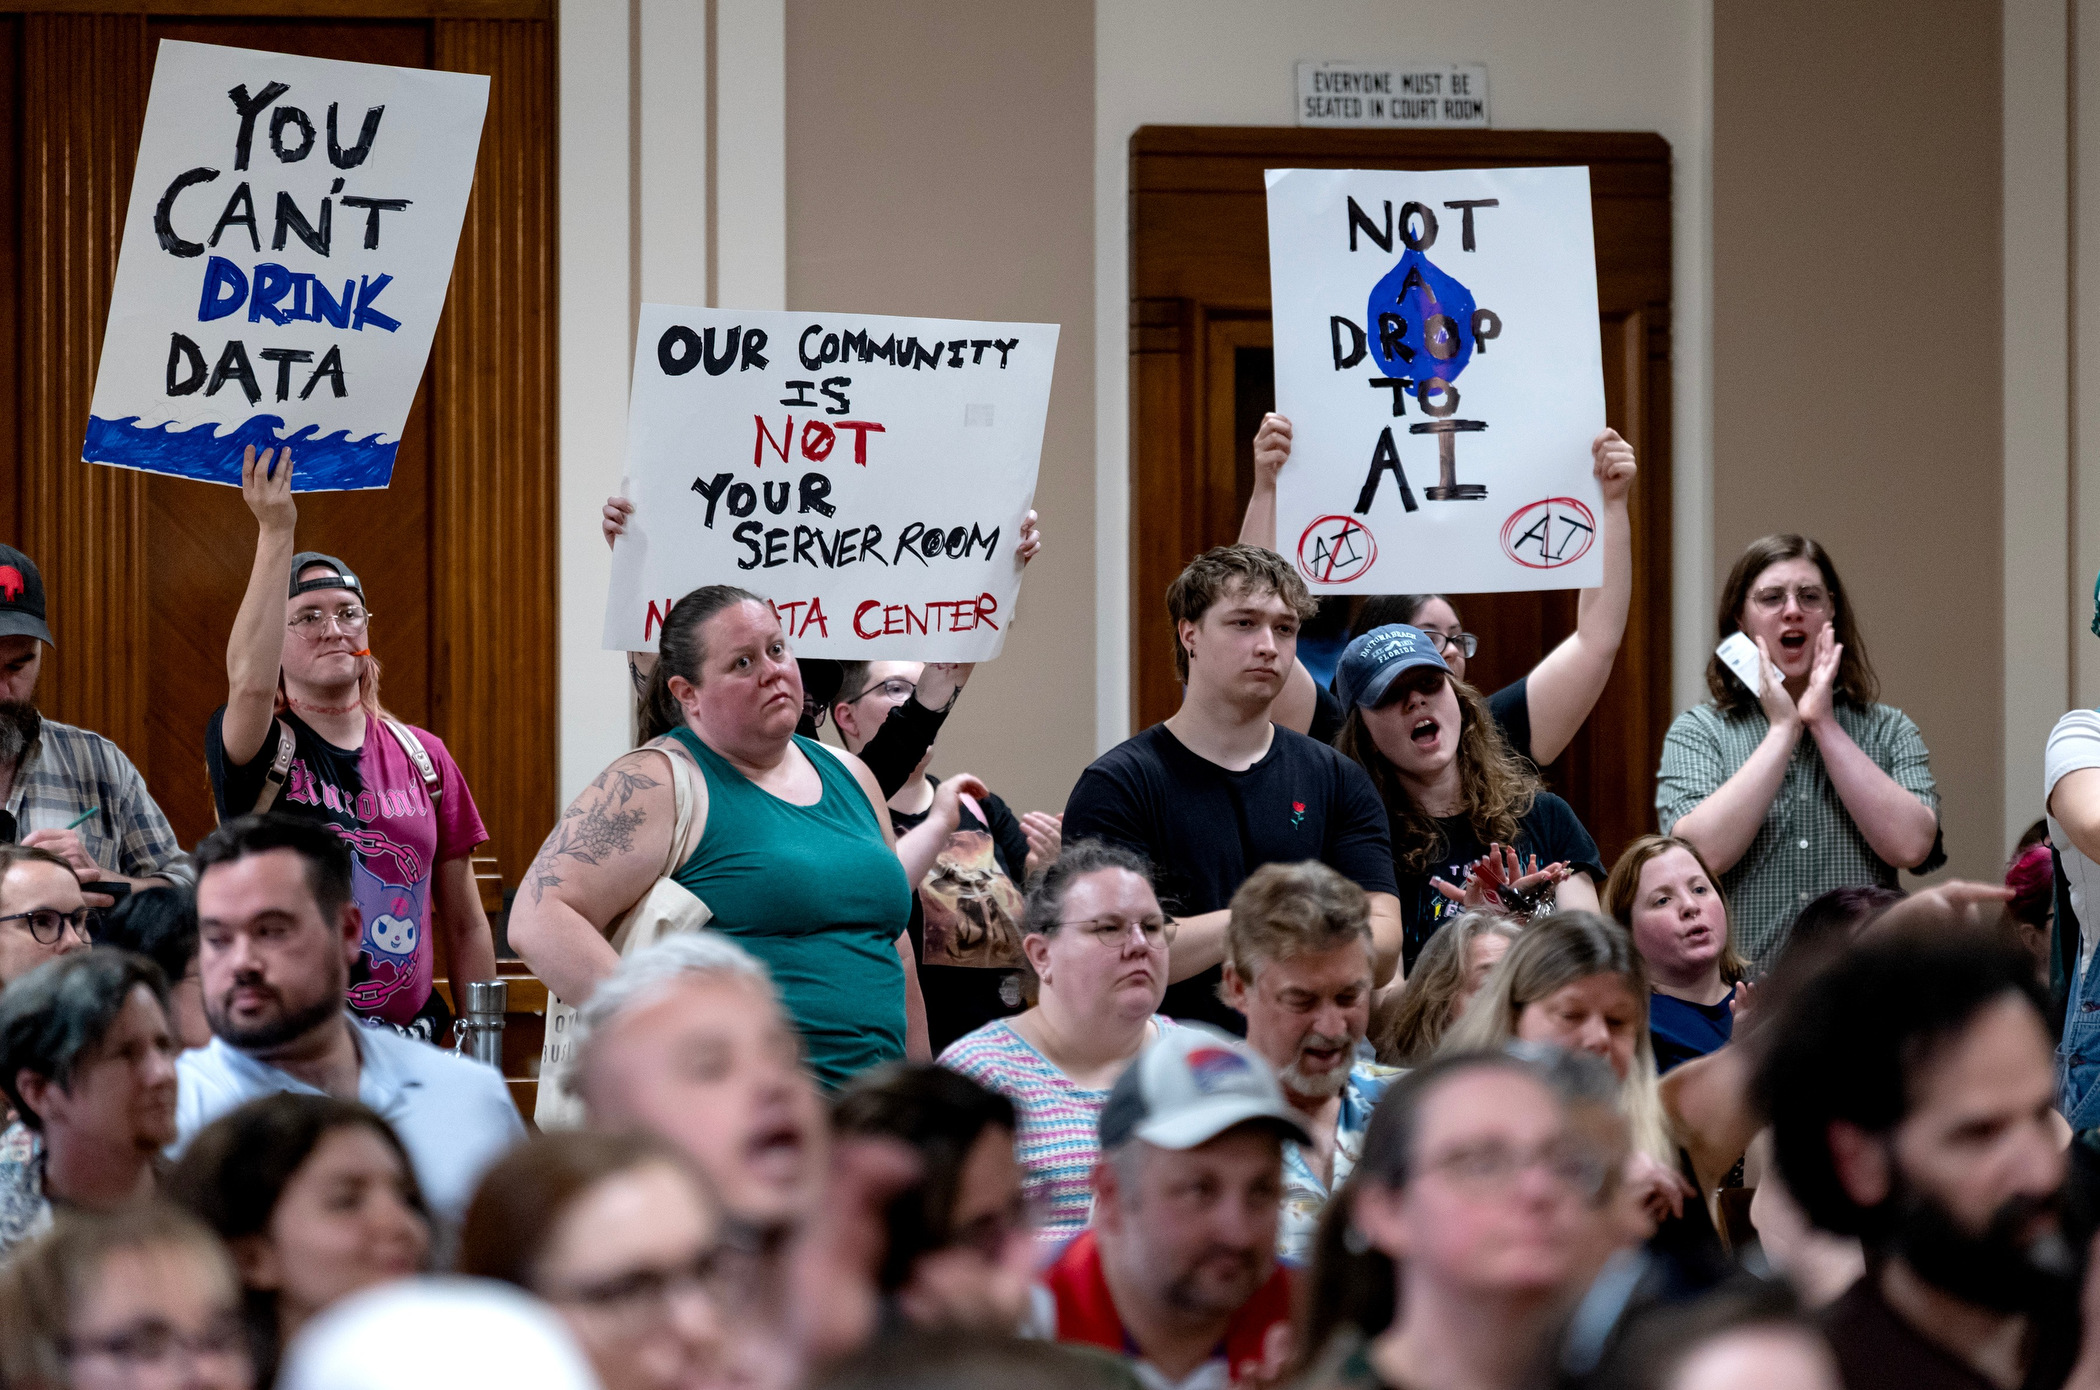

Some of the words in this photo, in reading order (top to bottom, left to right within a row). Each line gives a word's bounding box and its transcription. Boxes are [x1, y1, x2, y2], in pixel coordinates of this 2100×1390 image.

[1305, 96, 1362, 118] SEATED
[1370, 98, 1384, 119] IN
[1392, 98, 1437, 120] COURT
[1444, 100, 1484, 120] ROOM
[1315, 72, 1391, 94] EVERYONE
[1401, 73, 1442, 94] MUST
[1452, 74, 1470, 95] BE
[228, 81, 385, 171] YOU
[153, 166, 413, 258] CAN'T
[1347, 195, 1499, 253] NOT
[198, 256, 402, 333] DRINK
[1396, 263, 1437, 304] A
[657, 324, 770, 376] OUR
[799, 324, 1019, 371] COMMUNITY
[1330, 309, 1503, 371] DROP
[166, 332, 348, 407] DATA
[780, 376, 852, 416] IS
[1368, 376, 1461, 418] TO
[754, 414, 886, 468] NOT
[1353, 419, 1489, 515] AI
[691, 472, 836, 529] YOUR
[733, 521, 889, 570] SERVER
[893, 521, 1001, 568] ROOM
[645, 598, 672, 641] N
[853, 592, 999, 640] CENTER
[1360, 632, 1391, 658] DAYTONA
[1377, 646, 1417, 663] FLORIDA
